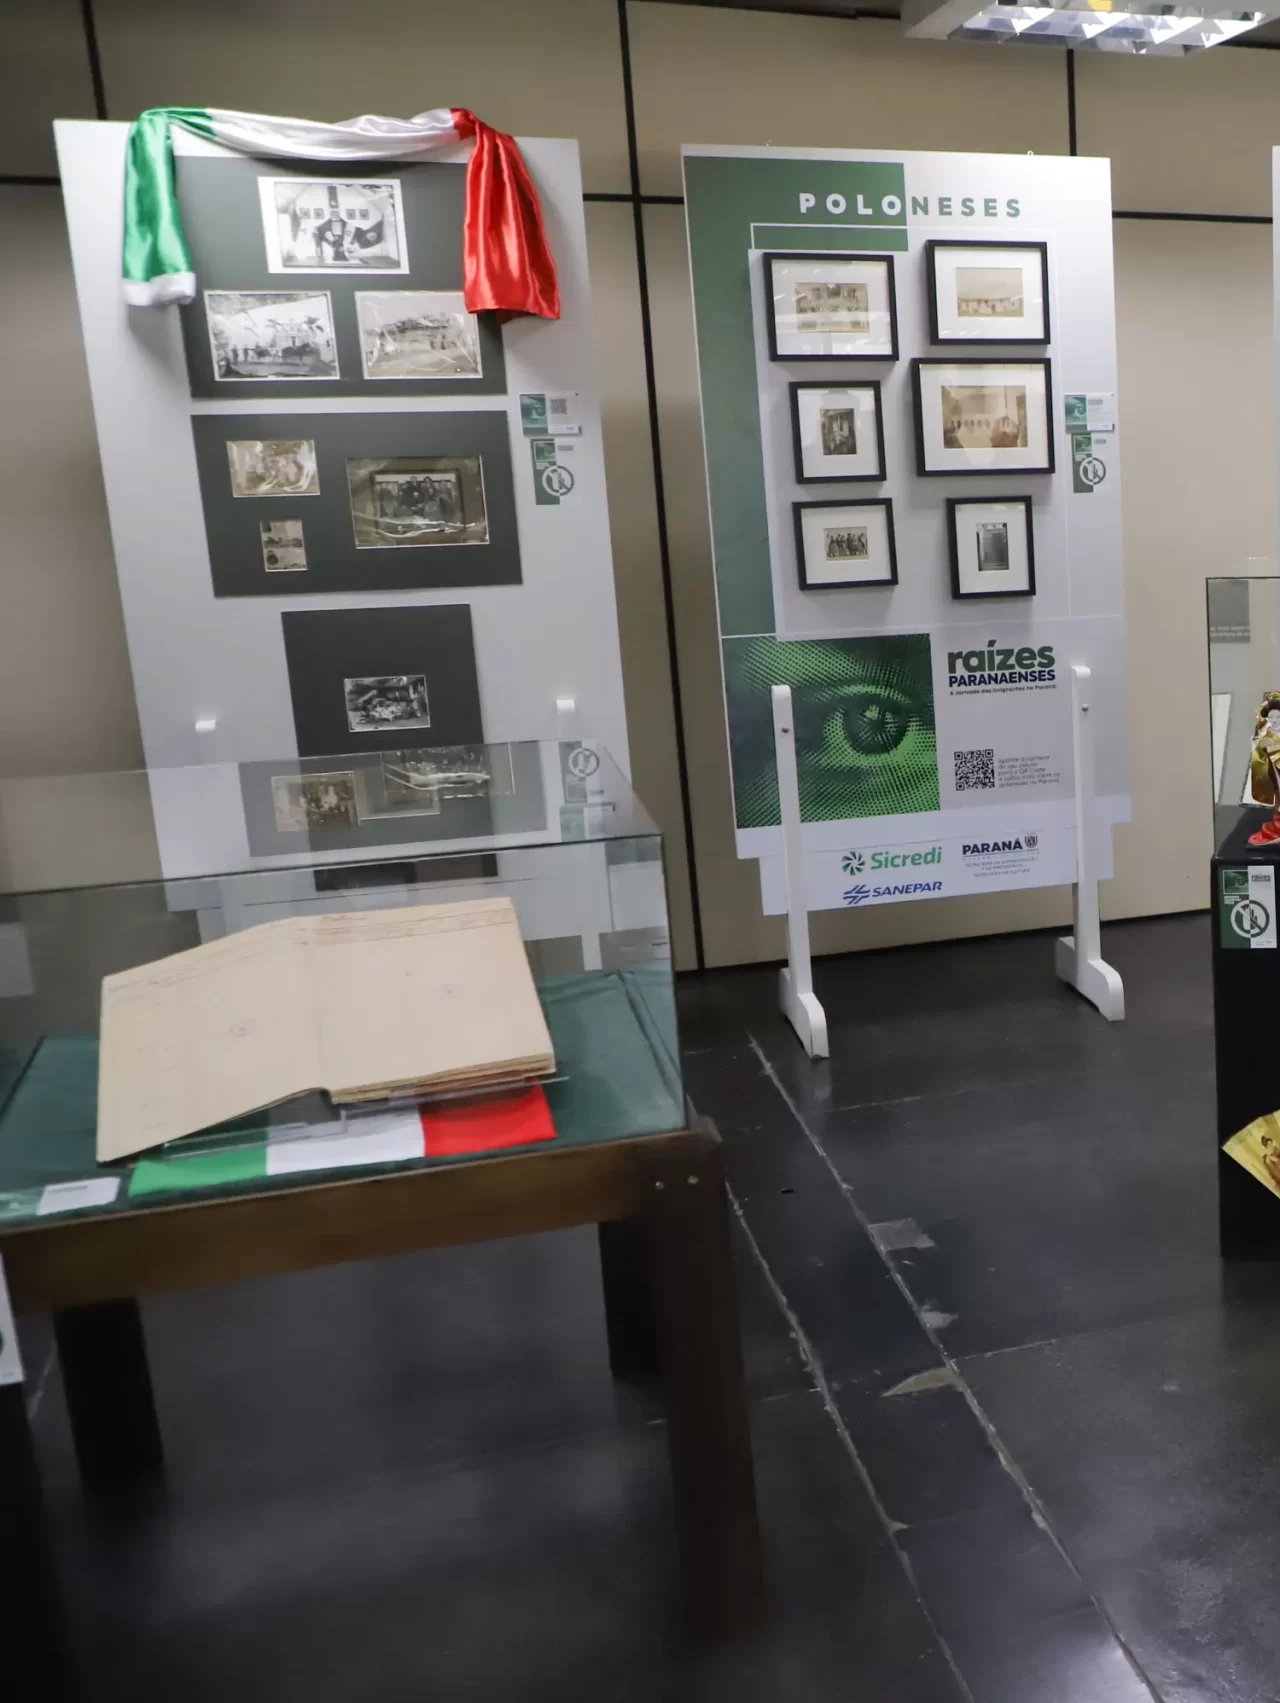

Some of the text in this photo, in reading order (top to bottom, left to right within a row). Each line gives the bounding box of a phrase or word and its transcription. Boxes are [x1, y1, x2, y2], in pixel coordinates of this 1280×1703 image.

[799, 192, 1021, 218] POLONESES
[947, 639, 1056, 674] raízes
[949, 669, 1056, 688] PARANAENSES
[962, 837, 1024, 855] PARANÁ
[870, 846, 943, 870] Sicredi
[872, 881, 943, 898] SANEPAR
